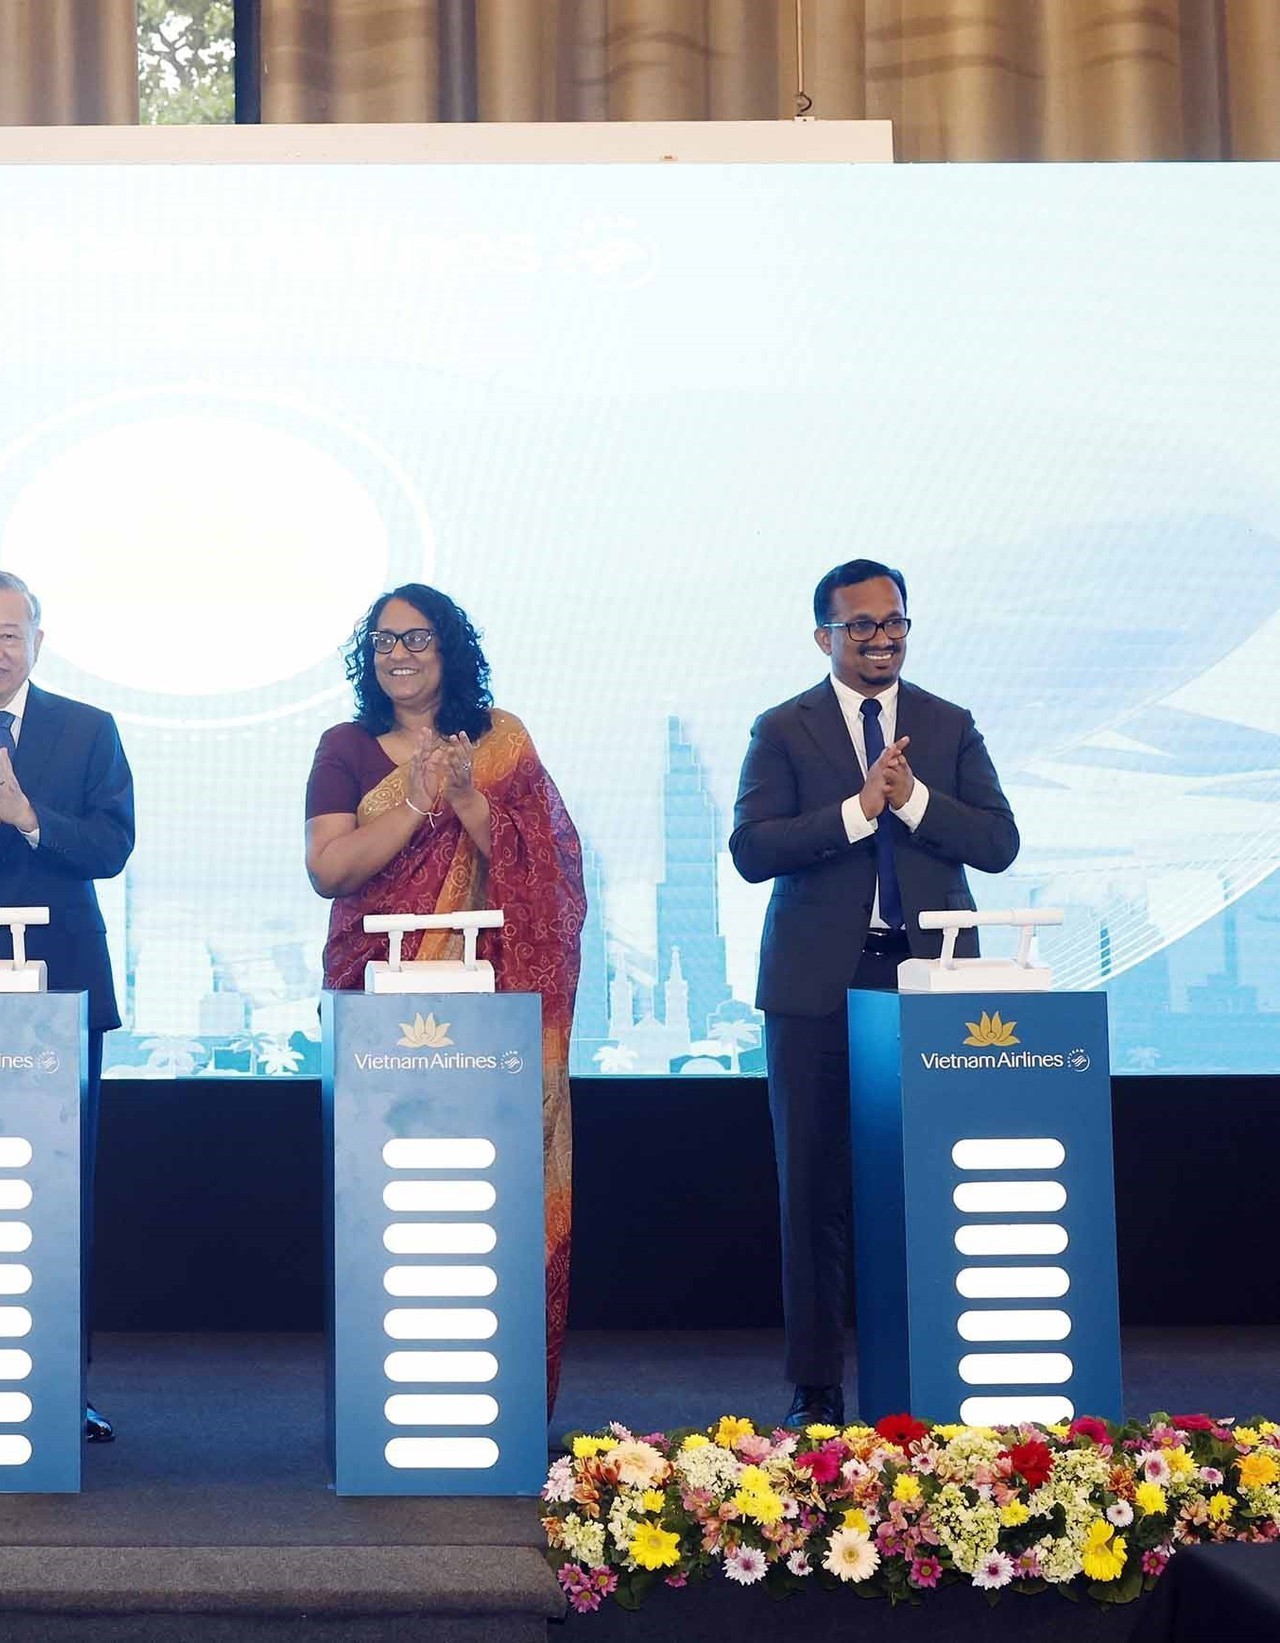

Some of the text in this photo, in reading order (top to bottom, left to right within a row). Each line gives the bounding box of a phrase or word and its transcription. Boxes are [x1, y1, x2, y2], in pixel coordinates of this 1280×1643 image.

[355, 1053, 429, 1070] Vietnam
[430, 1052, 497, 1070] Airlines
[921, 1052, 996, 1069] Vietnam
[997, 1051, 1064, 1068] Airlines
